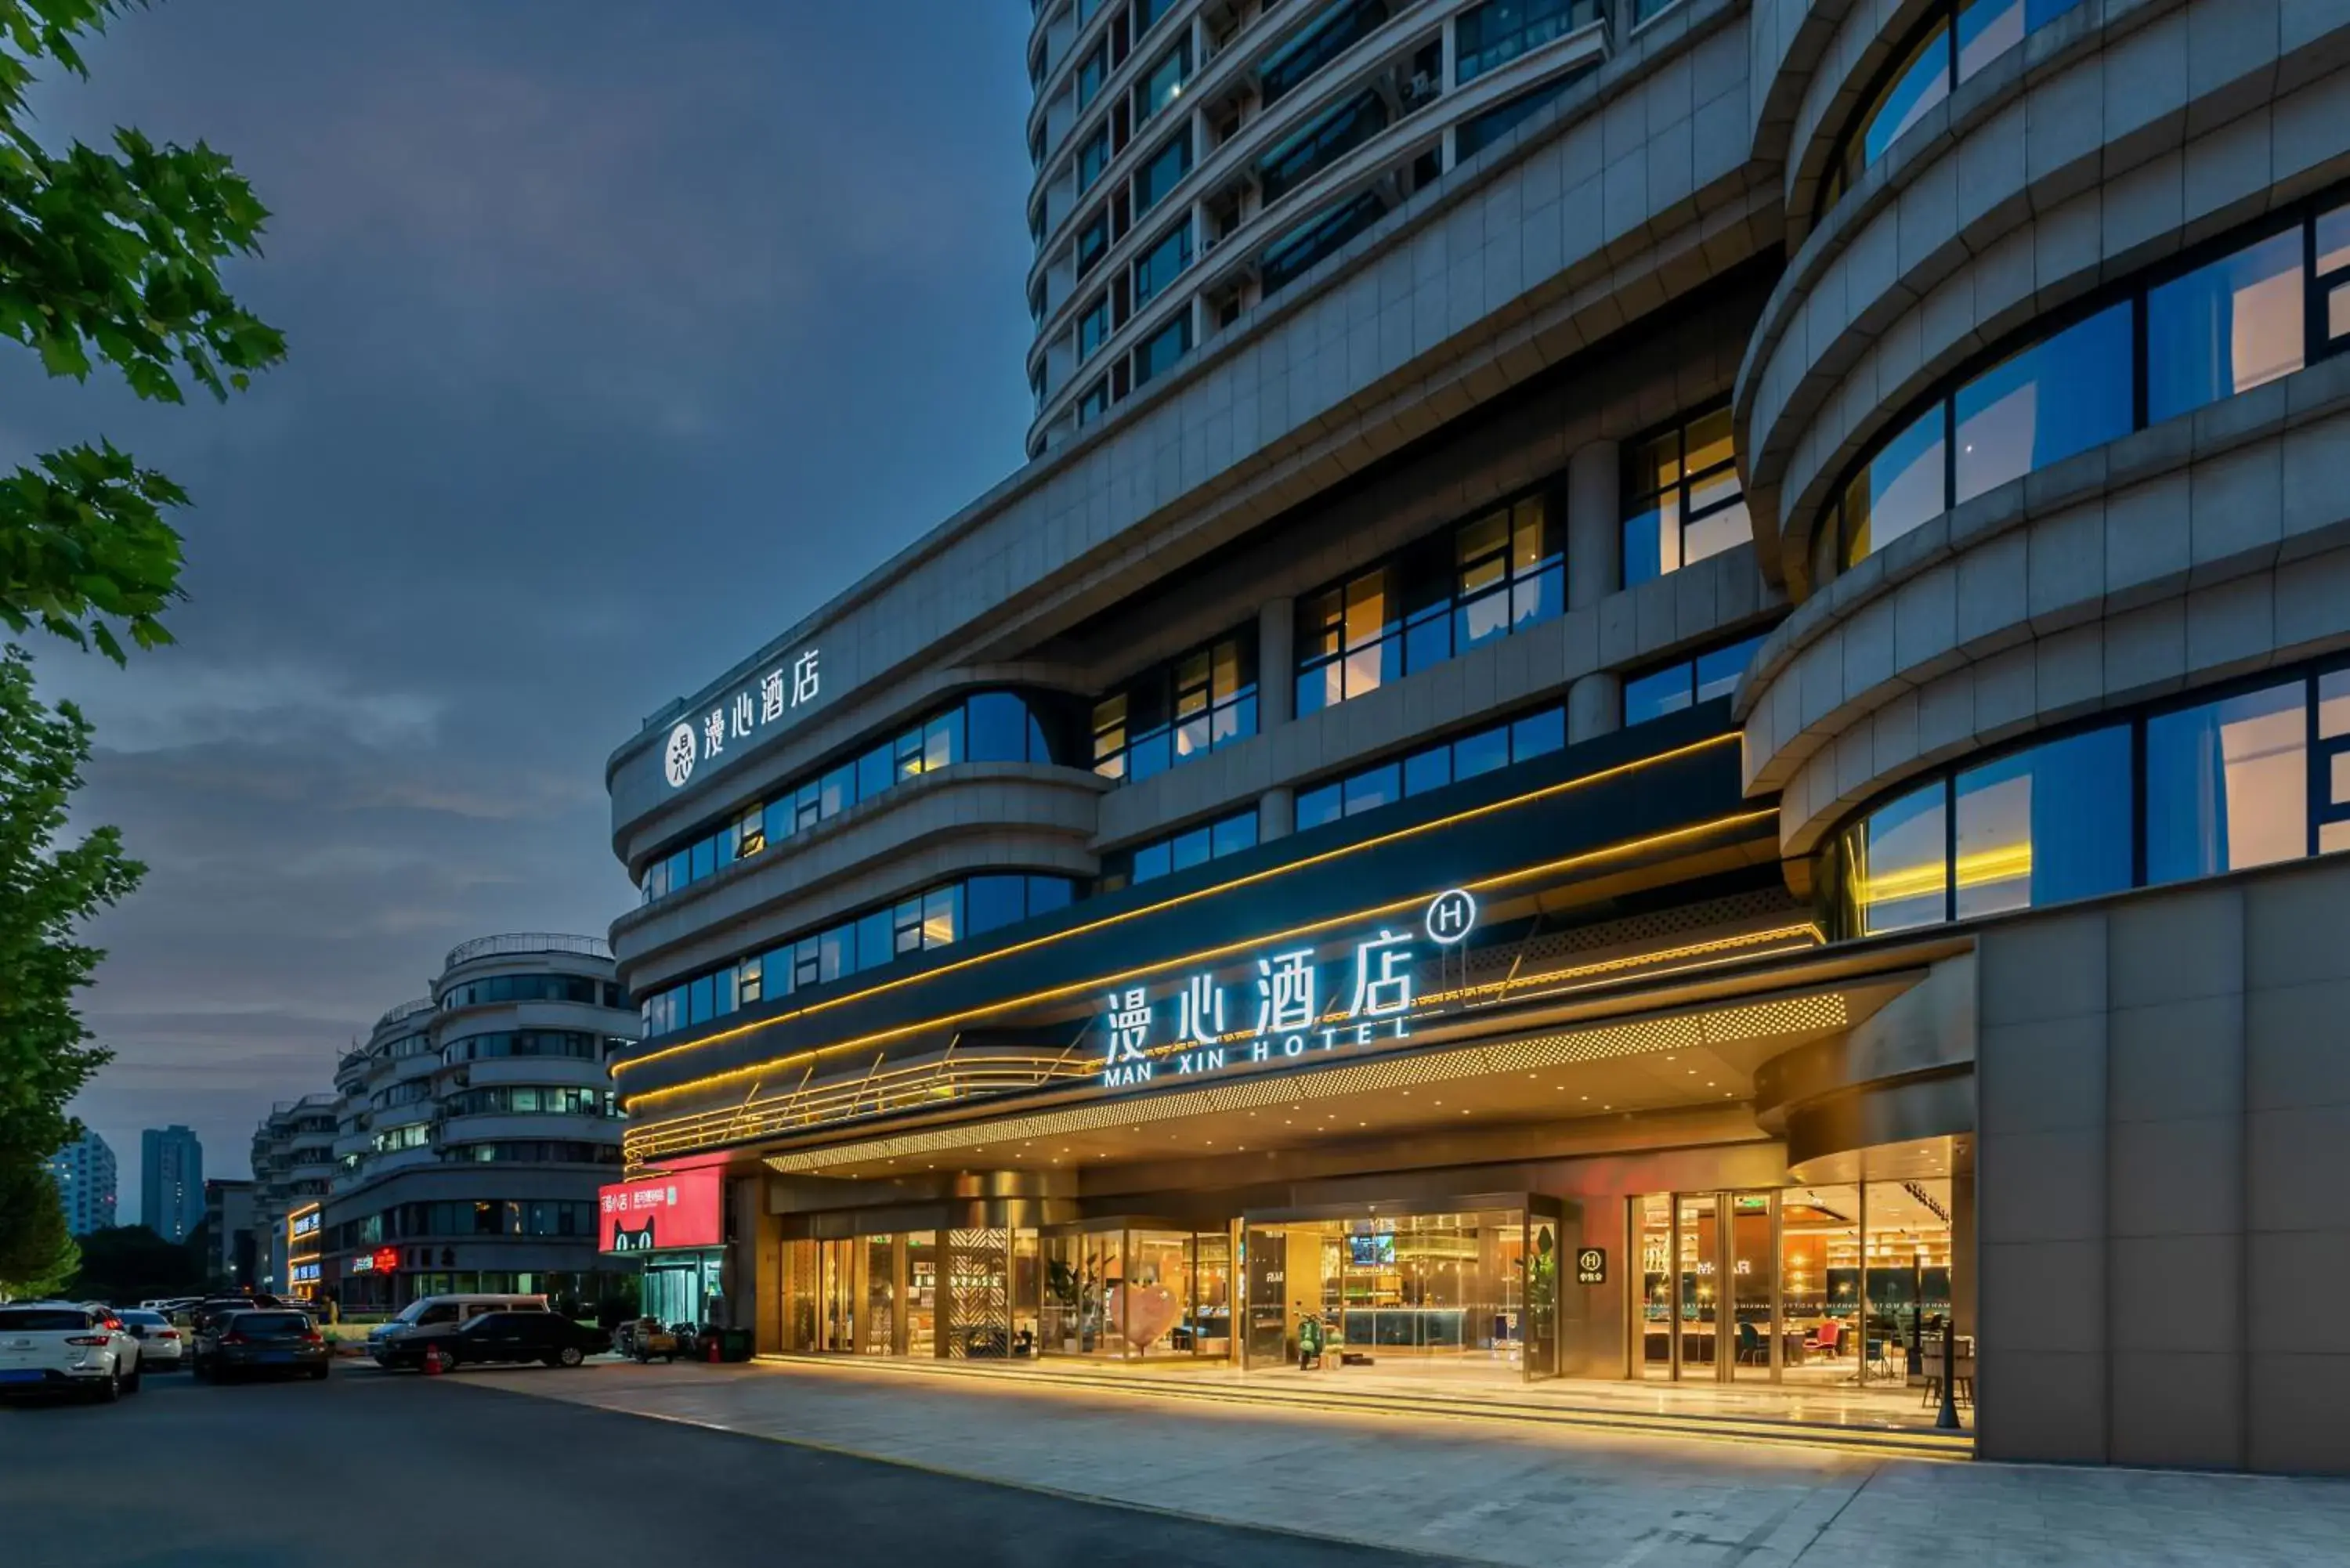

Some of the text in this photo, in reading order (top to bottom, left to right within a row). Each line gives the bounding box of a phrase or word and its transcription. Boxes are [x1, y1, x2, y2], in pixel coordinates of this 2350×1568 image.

[704, 649, 819, 760] 漫心酒店
[1104, 1017, 1410, 1087] MAN XIN HOTEL
[1106, 930, 1413, 1065] 漫心酒店
